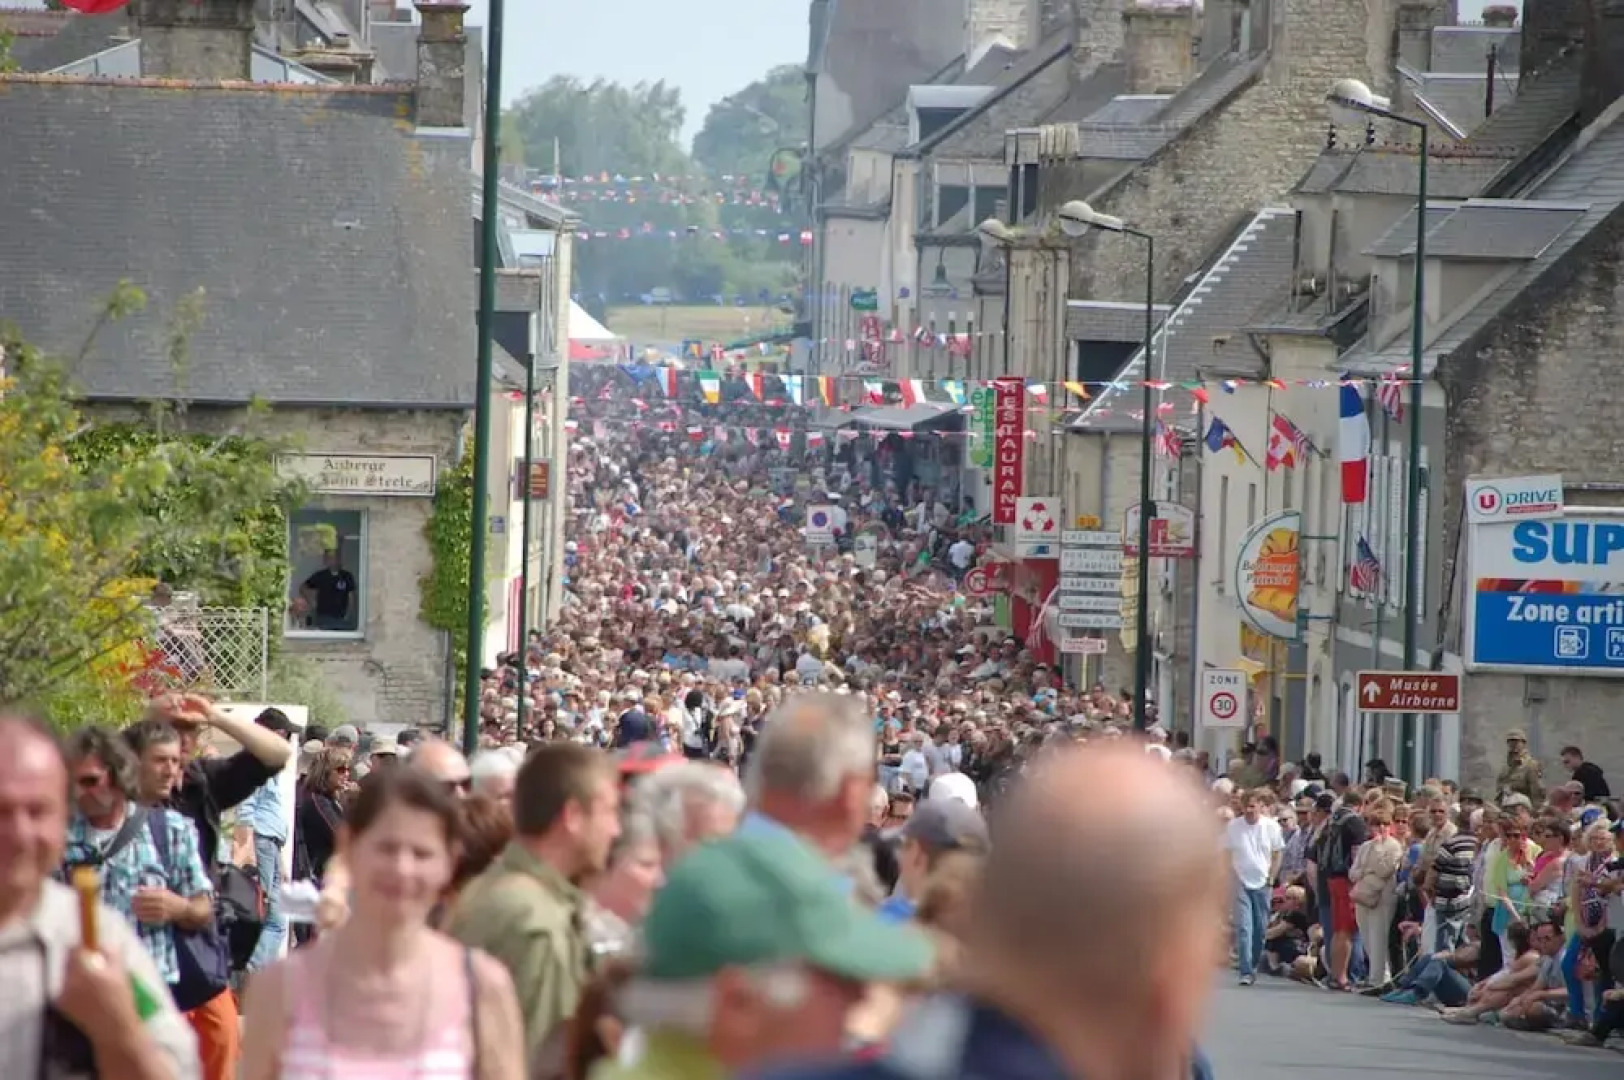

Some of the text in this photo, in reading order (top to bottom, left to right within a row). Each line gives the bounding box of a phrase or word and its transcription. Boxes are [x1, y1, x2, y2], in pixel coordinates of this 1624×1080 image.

[1000, 384, 1016, 518] RESTAURANT
[323, 459, 386, 471] Auberge
[365, 475, 413, 487] Steele
[1480, 489, 1558, 508] U DRIVE
[1512, 520, 1624, 565] SUP
[1507, 596, 1623, 623] Zone arti
[1210, 675, 1239, 684] ZONE
[1389, 678, 1438, 691] Musée
[1217, 699, 1231, 711] 30
[1389, 693, 1455, 708] Airborne
